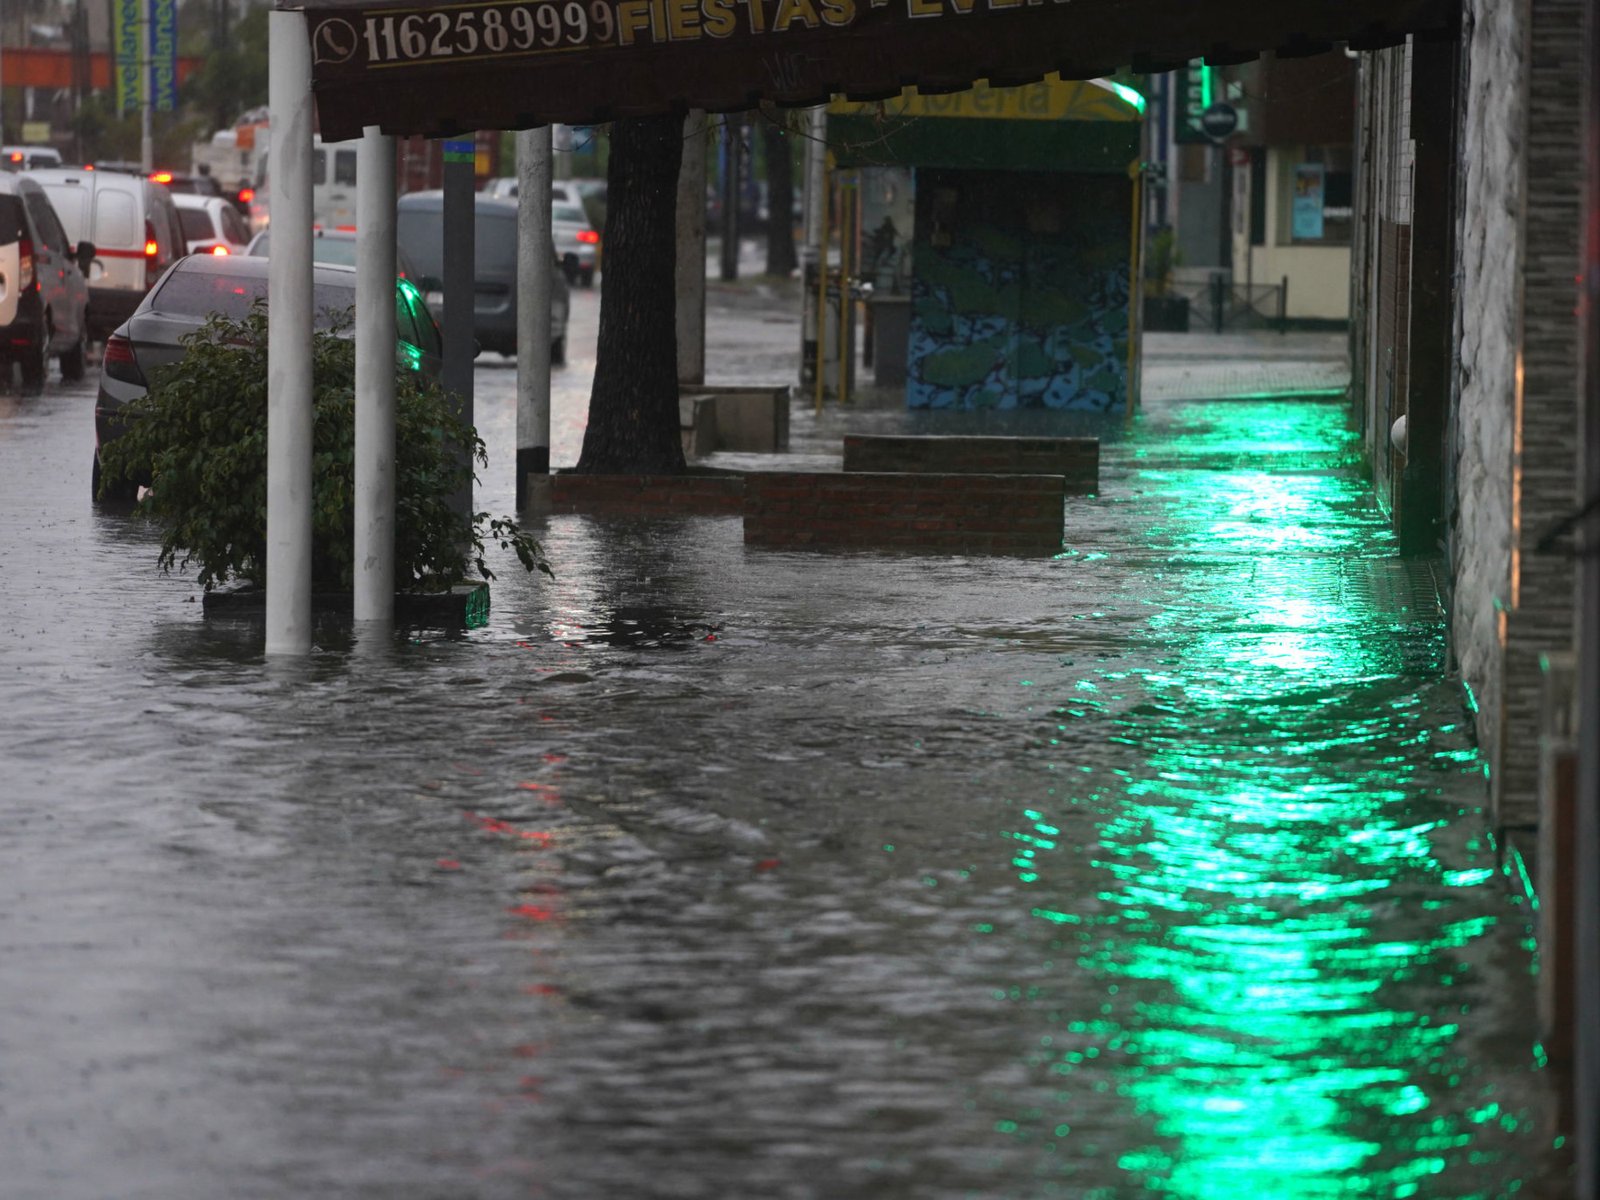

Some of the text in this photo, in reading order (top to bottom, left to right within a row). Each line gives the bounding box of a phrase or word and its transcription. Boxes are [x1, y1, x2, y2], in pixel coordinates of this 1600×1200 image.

[118, 0, 138, 109] avellane
[363, 0, 857, 61] 1162589999 FIESTAS
